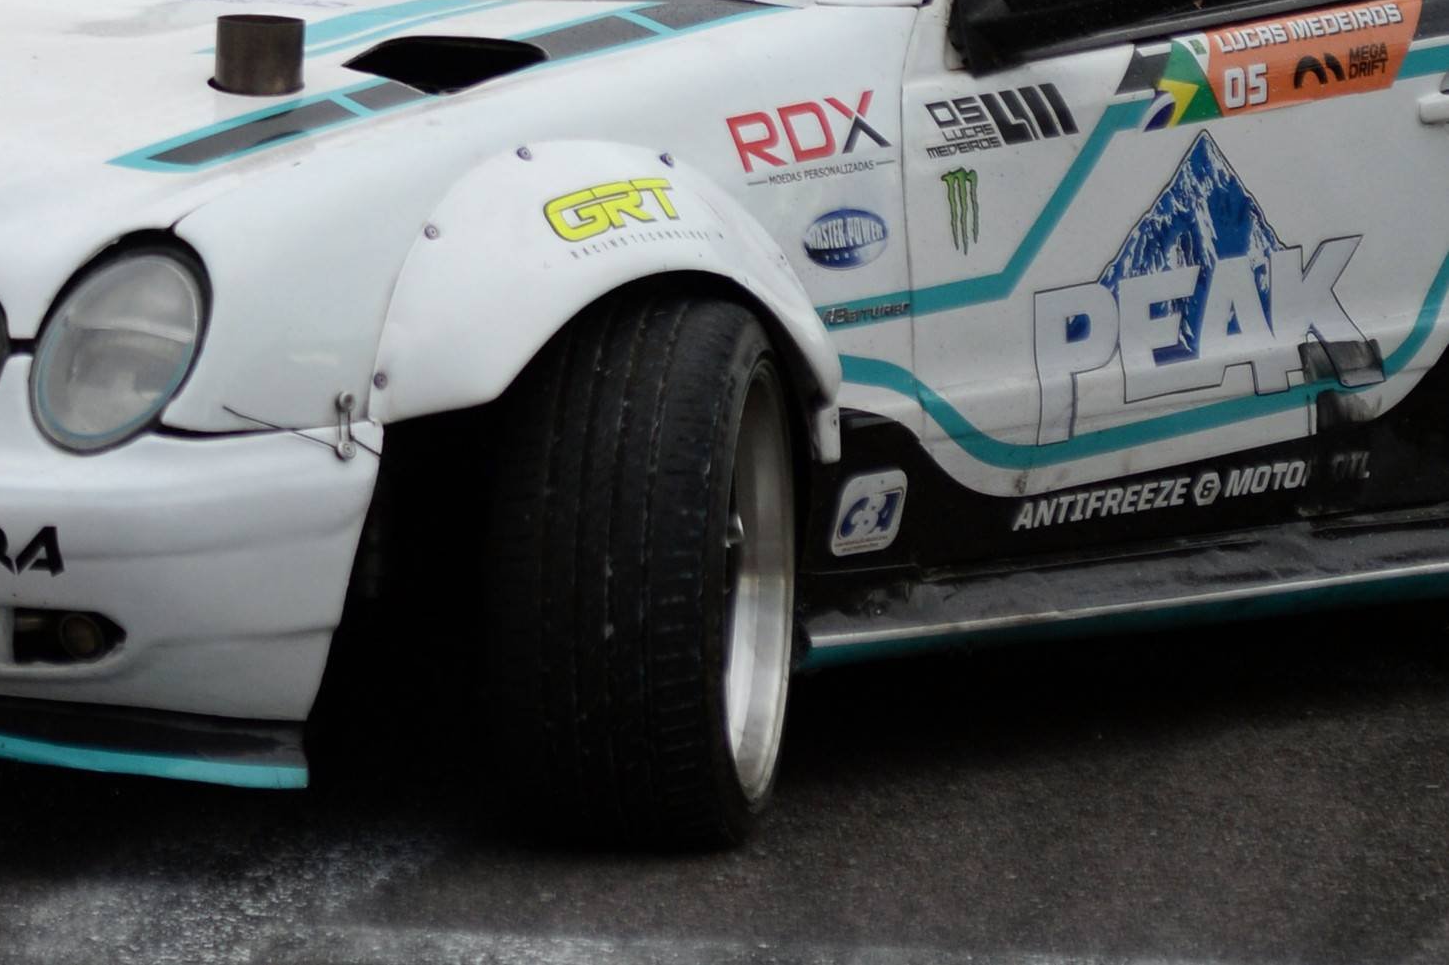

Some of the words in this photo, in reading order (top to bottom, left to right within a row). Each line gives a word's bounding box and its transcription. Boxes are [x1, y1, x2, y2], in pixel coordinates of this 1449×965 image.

[1214, 22, 1289, 53] LUCAS
[1287, 4, 1404, 40] MEDEIROS
[1349, 58, 1389, 80] DRIFT
[1350, 42, 1389, 62] MEGA
[1224, 63, 1268, 109] 05
[726, 90, 892, 173] RDX
[926, 136, 1003, 159] MEDEIROS
[942, 123, 997, 142] LUCAS
[768, 171, 803, 186] MOEDAS
[804, 159, 875, 180] PERSONALIZADAS
[543, 178, 680, 242] GRT
[1034, 234, 1387, 447] PEAK
[1012, 477, 1192, 531] ANTIFREEZE
